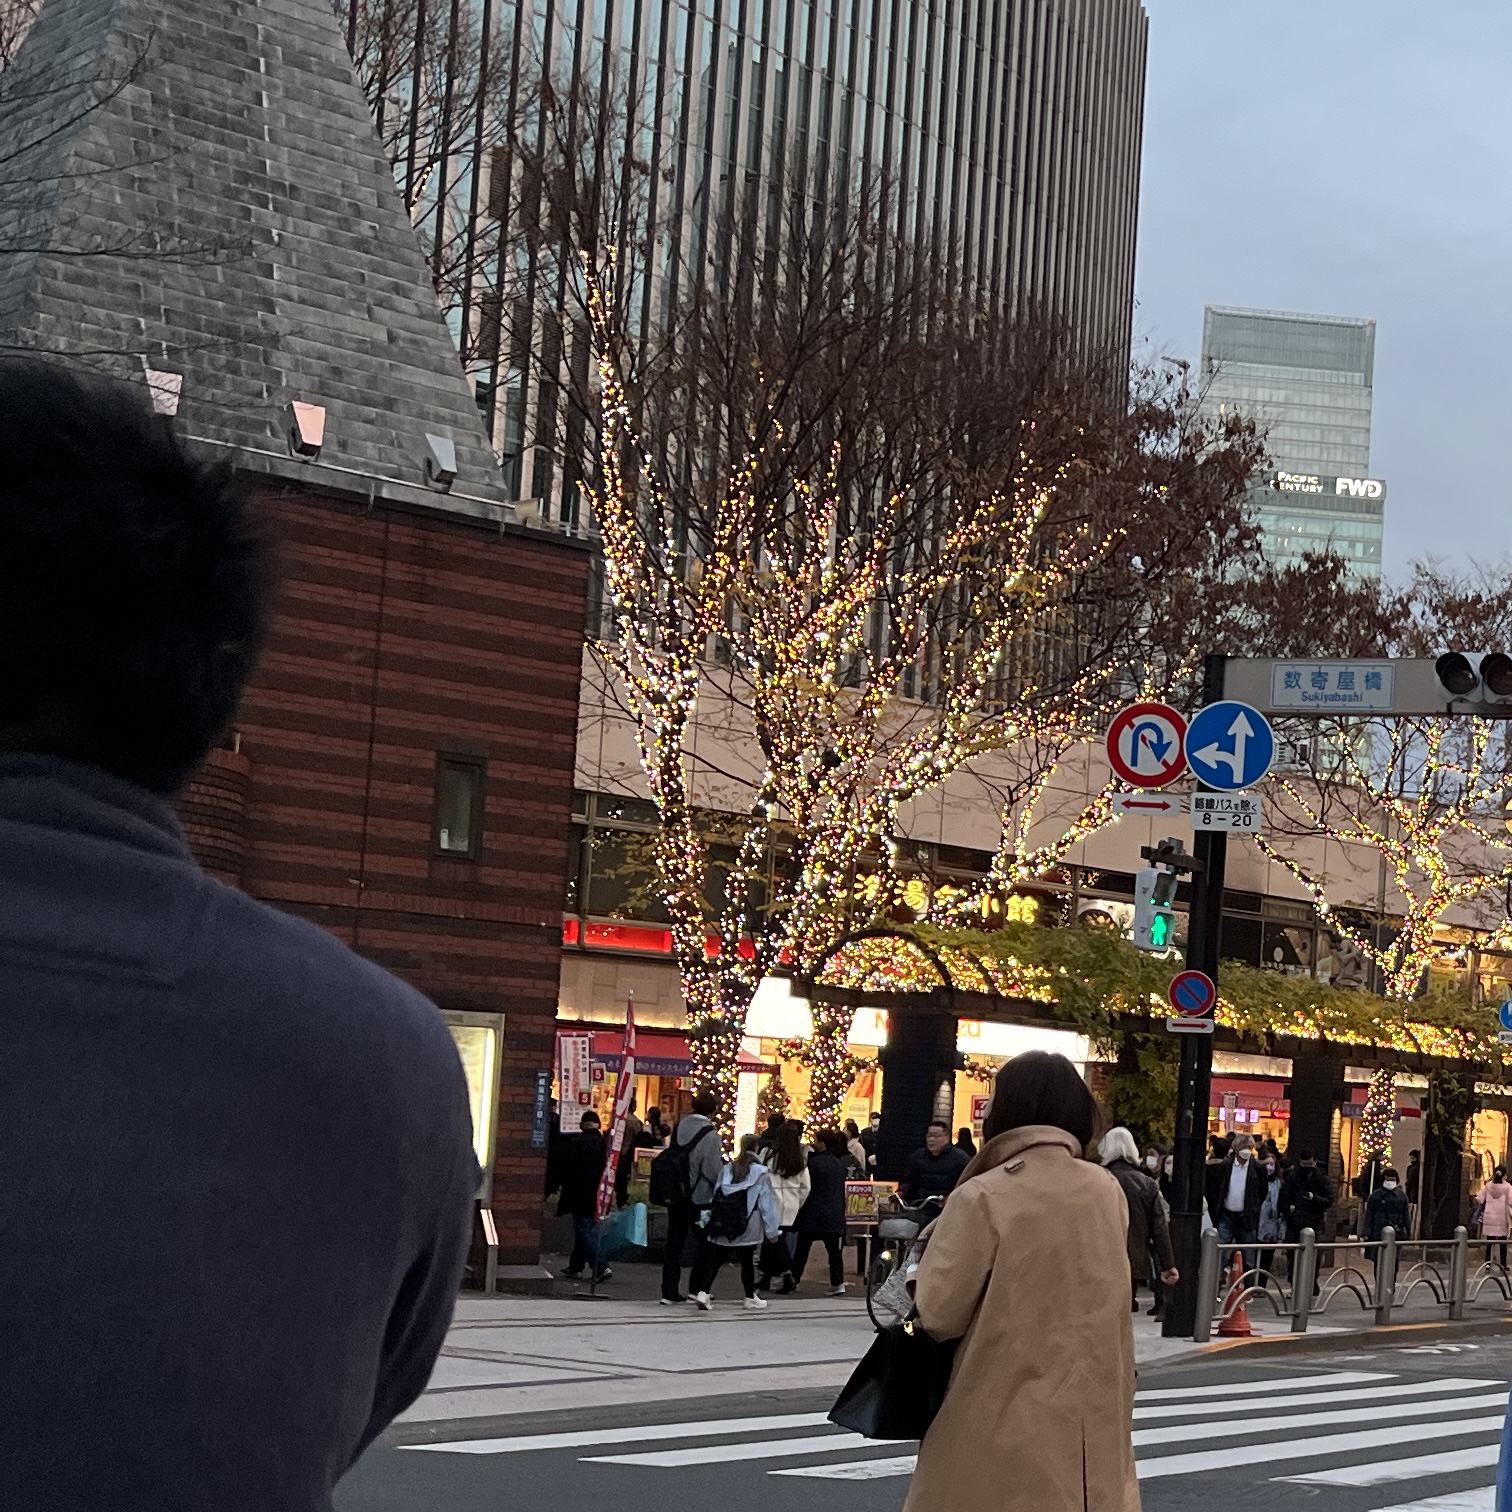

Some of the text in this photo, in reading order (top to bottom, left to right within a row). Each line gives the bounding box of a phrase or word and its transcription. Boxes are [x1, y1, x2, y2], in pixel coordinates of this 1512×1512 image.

[1278, 472, 1319, 484] PACIFIC
[1335, 478, 1382, 497] FWD
[1284, 671, 1382, 690] 数寄屋橋
[1301, 691, 1363, 704] Sukiyabashi
[1195, 798, 1257, 812] 路線バスを除く
